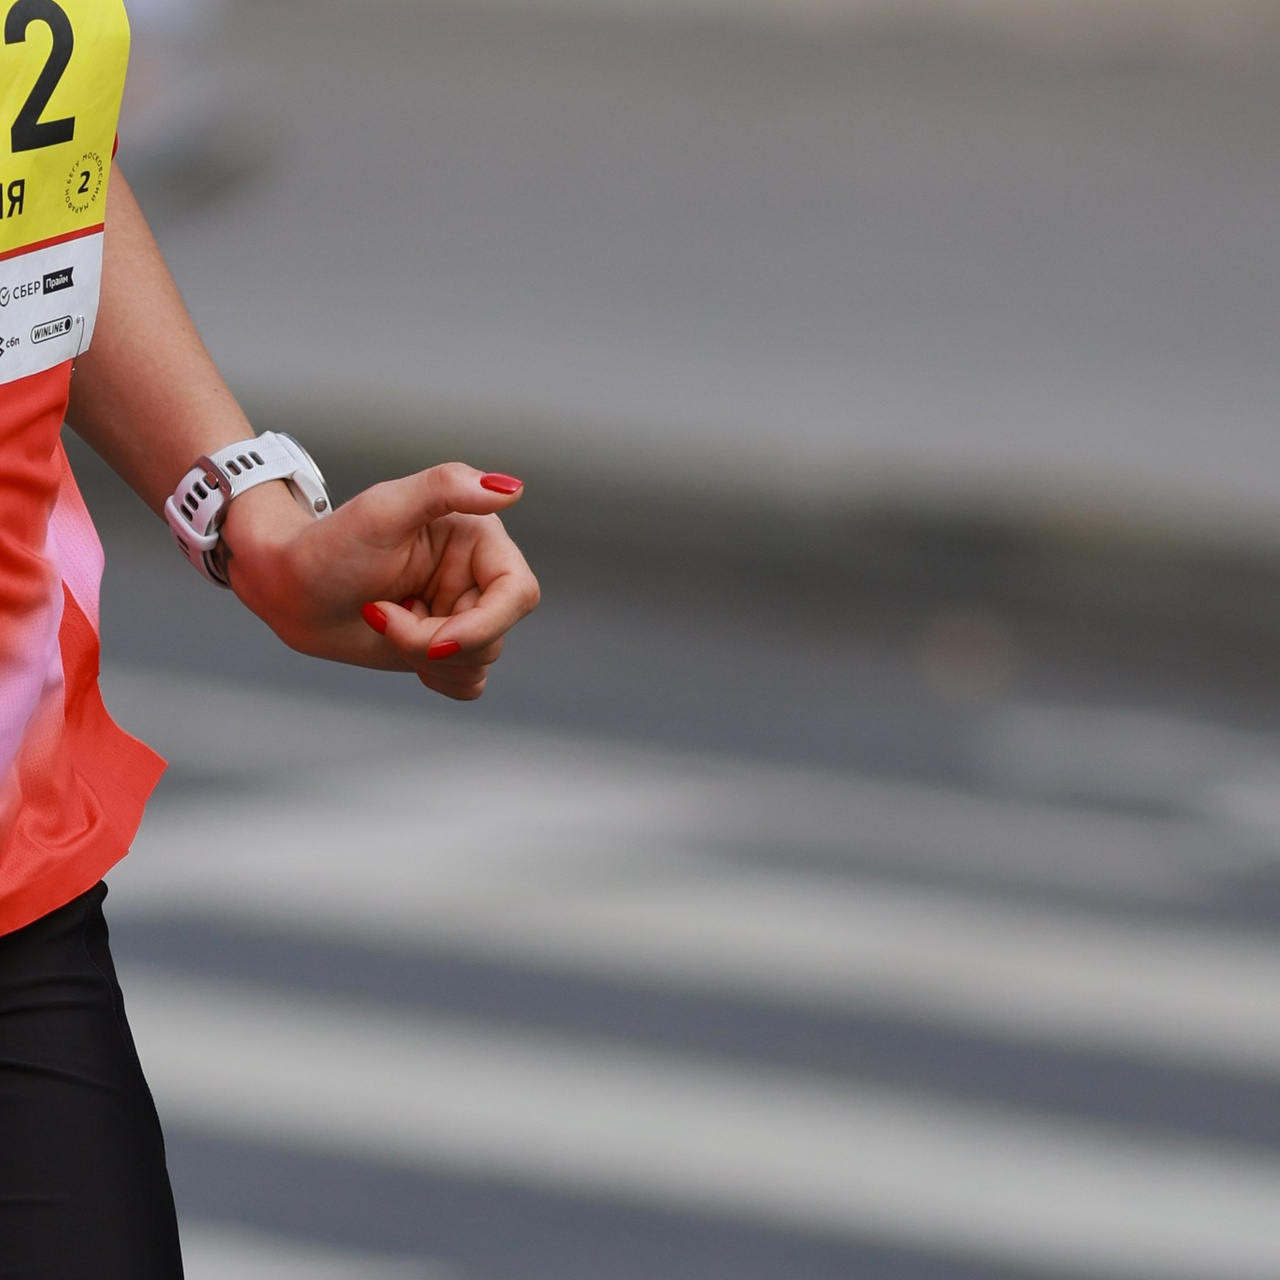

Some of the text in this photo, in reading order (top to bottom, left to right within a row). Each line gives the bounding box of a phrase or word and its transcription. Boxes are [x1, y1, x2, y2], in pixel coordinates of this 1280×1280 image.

[77, 170, 90, 194] 2
[12, 274, 69, 300] СБЕР Прайм
[33, 322, 64, 340] WINLINE
